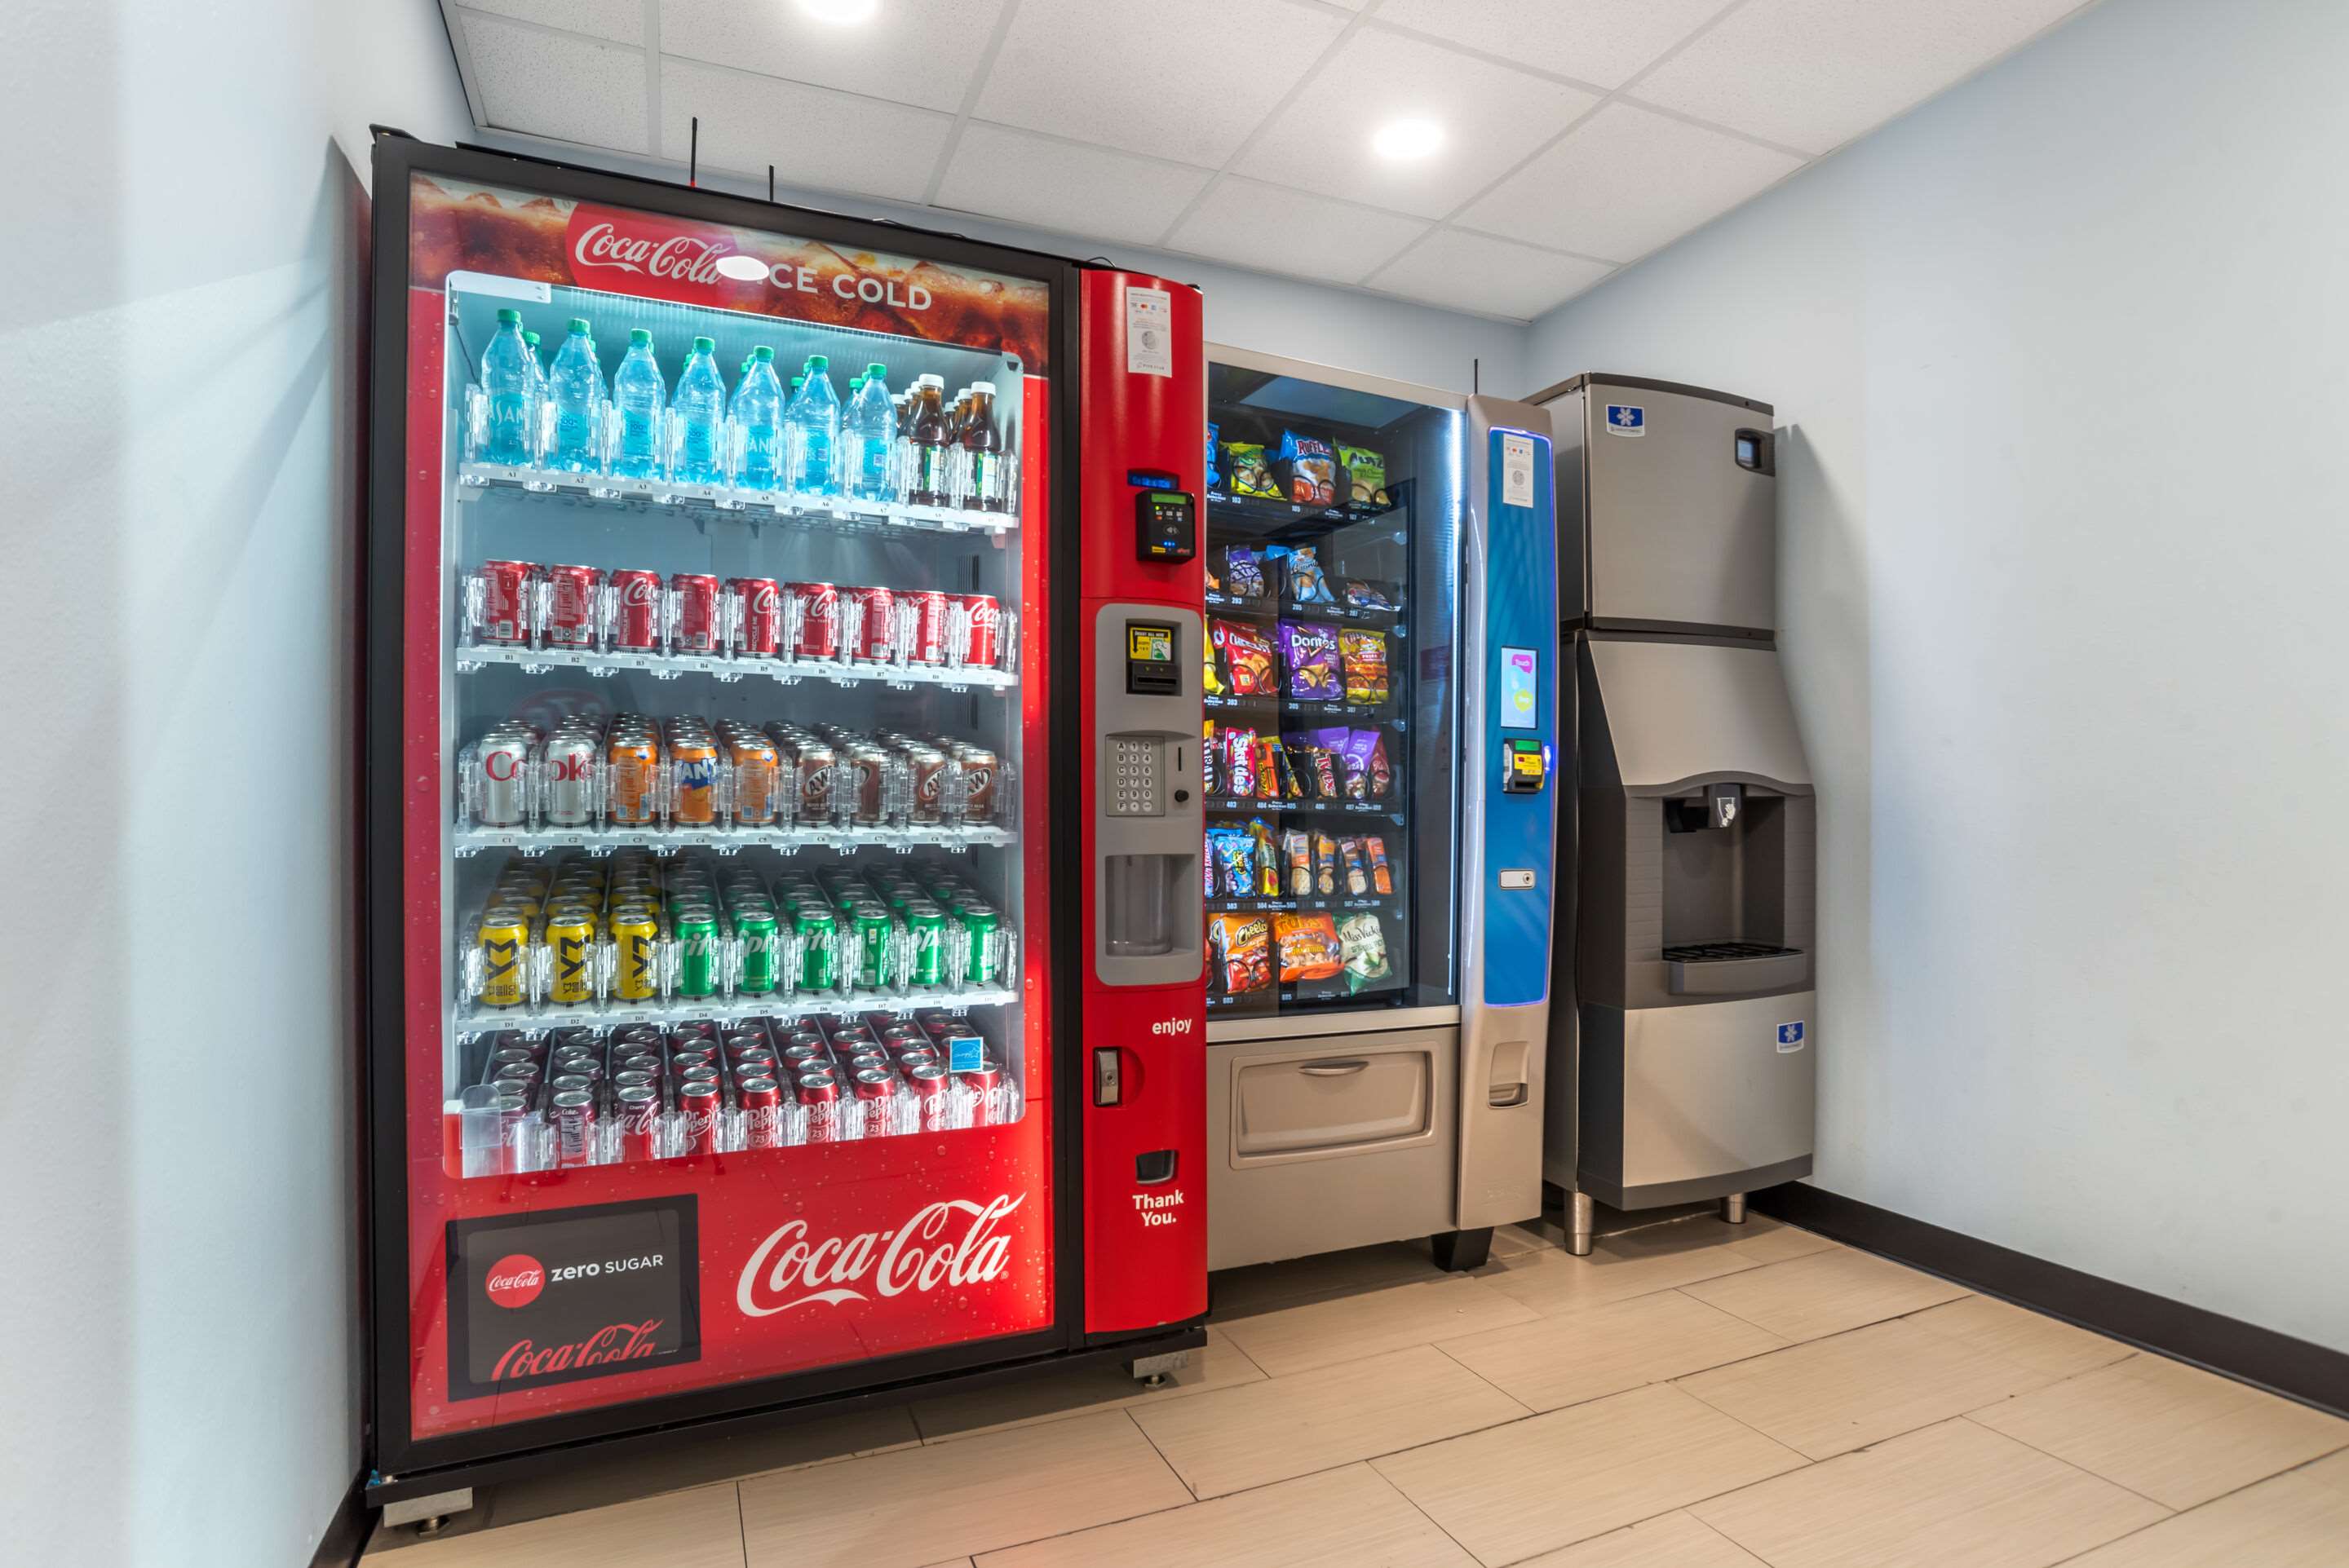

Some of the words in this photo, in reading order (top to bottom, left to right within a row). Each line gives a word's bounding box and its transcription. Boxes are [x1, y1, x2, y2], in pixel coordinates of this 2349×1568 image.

[756, 261, 818, 294] CE
[832, 273, 932, 311] COLD
[1295, 439, 1332, 456] RUFFL
[1291, 634, 1335, 650] Doritos
[1236, 919, 1267, 946] Cheeto
[1152, 1018, 1192, 1036] enjoy
[1132, 1190, 1184, 1210] Thank
[1141, 1212, 1176, 1226] You.
[737, 1191, 1028, 1318] Coca-Cola
[489, 1269, 542, 1292] Coca-Cola
[551, 1263, 600, 1283] zero
[604, 1254, 664, 1274] SUGAR
